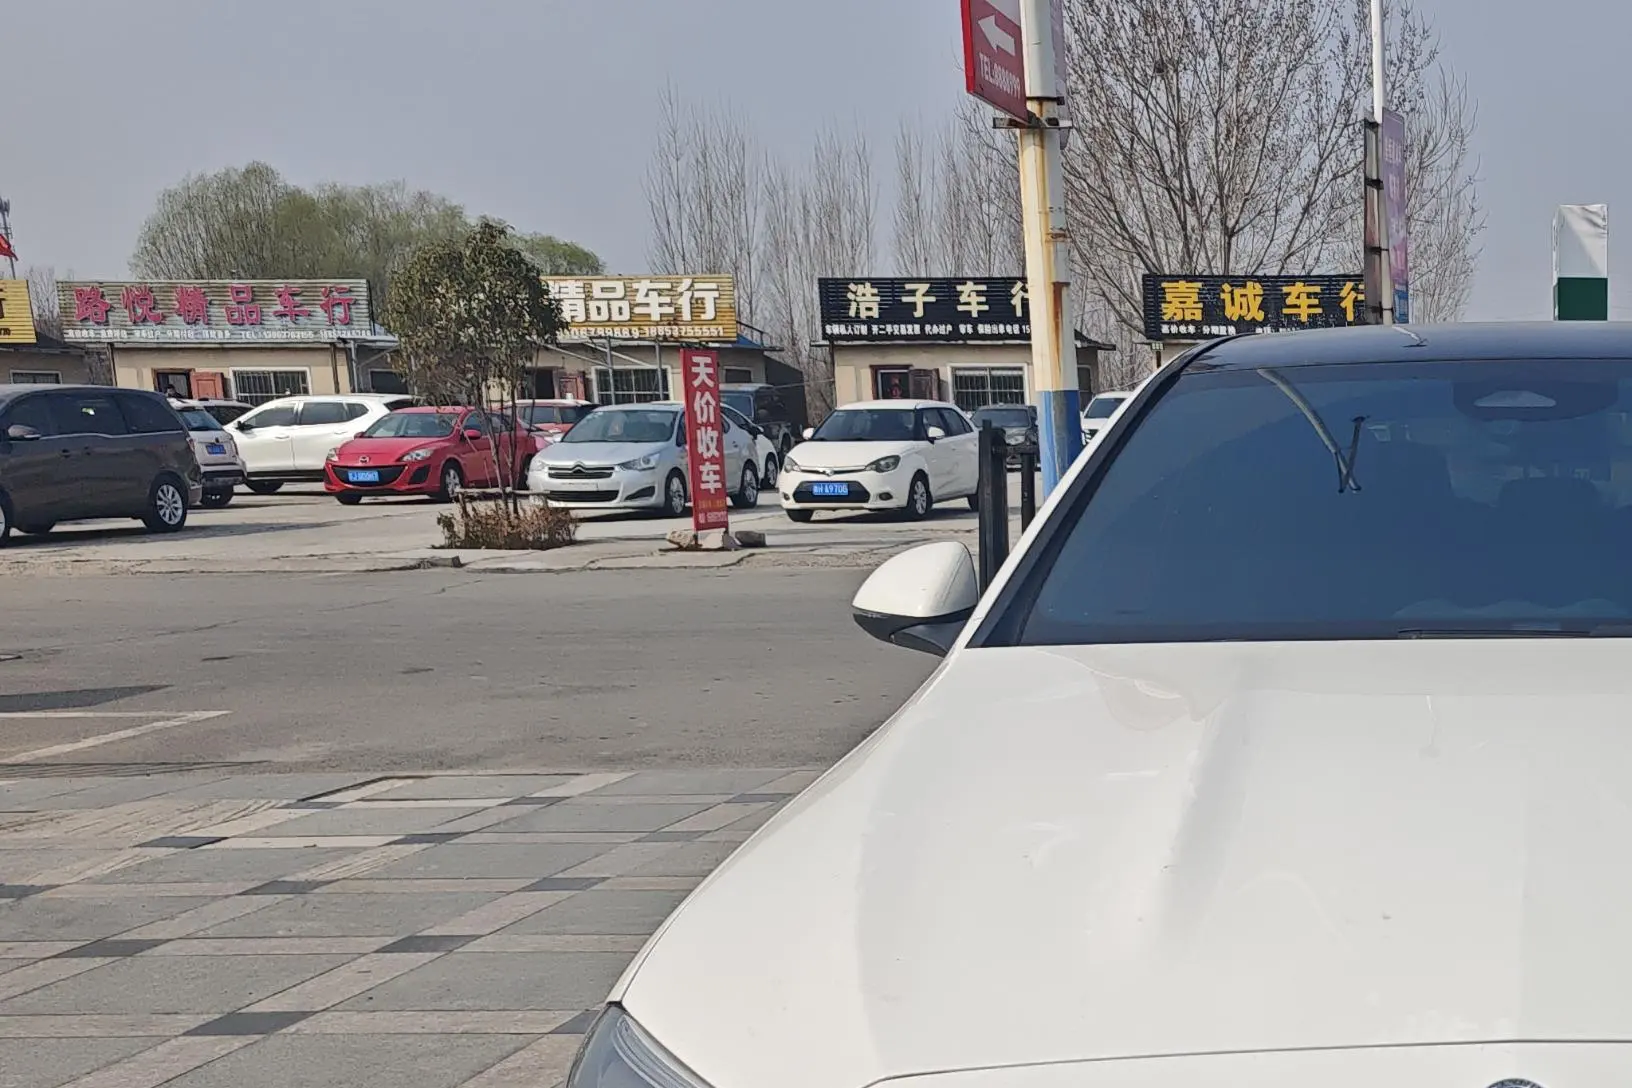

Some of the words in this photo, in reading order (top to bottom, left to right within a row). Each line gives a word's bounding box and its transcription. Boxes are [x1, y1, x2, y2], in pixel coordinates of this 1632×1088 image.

[73, 285, 356, 326] 路悦精品车行
[691, 356, 722, 494] 天价收车
